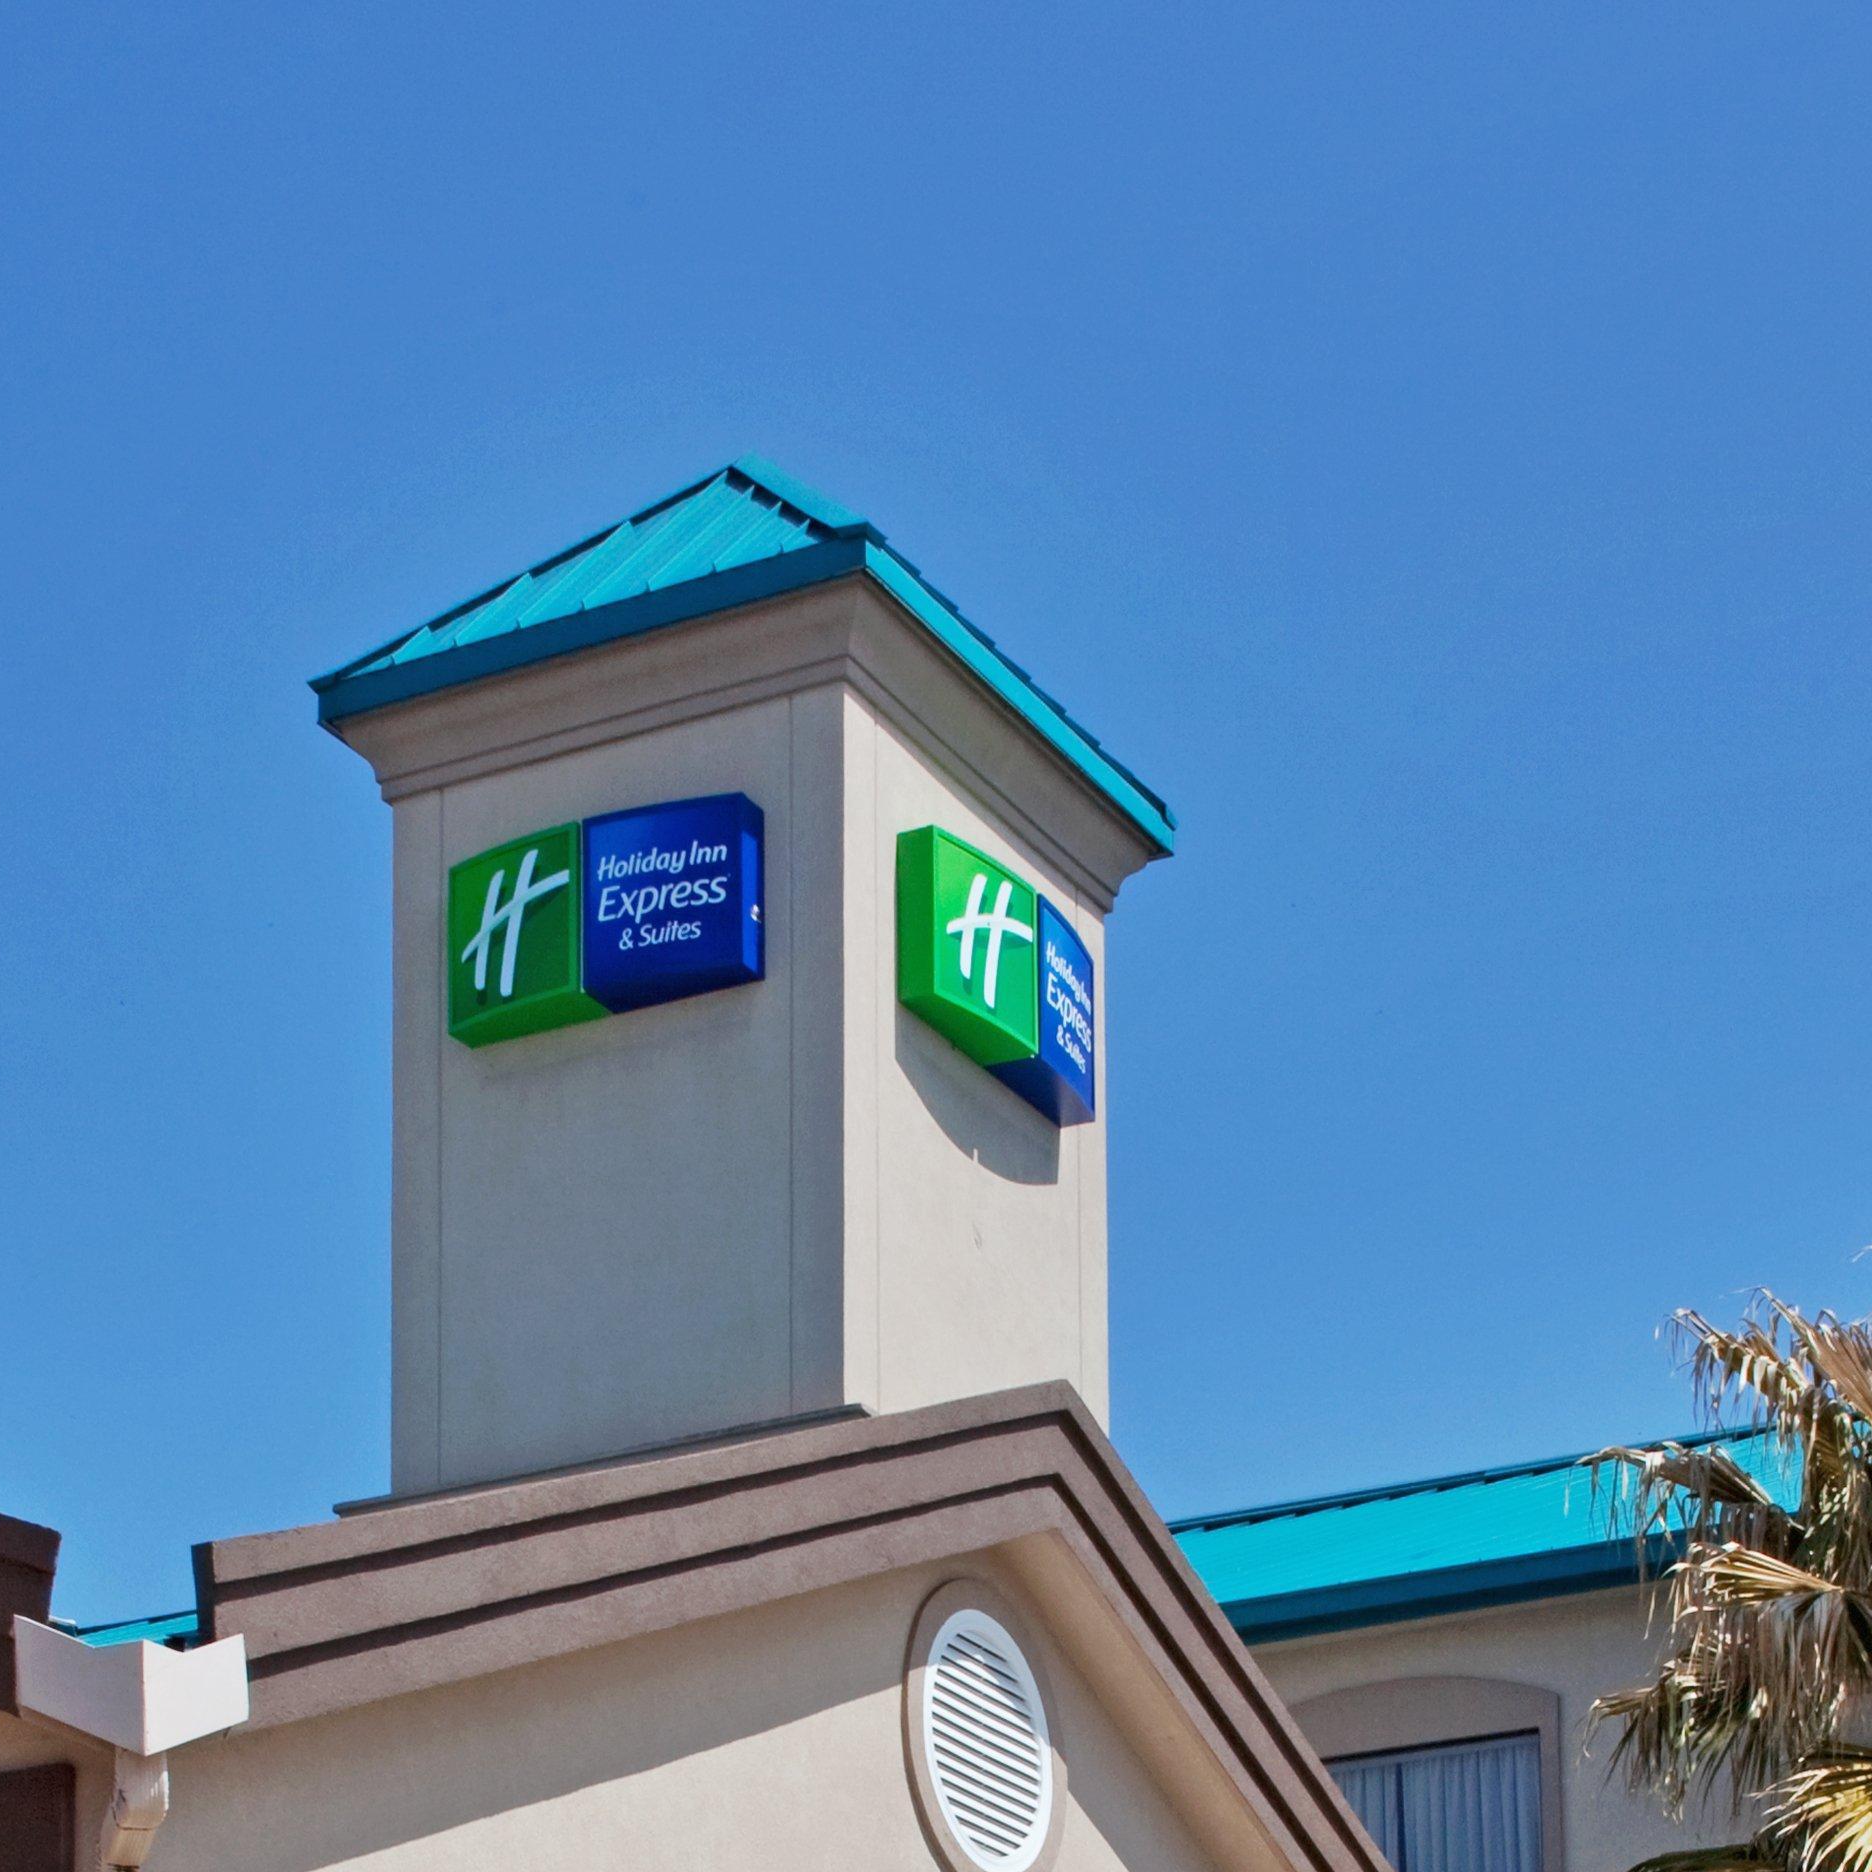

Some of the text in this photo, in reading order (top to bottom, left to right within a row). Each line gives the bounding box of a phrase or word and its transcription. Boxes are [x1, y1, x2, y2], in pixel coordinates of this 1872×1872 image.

[597, 840, 728, 882] Holiday Inn
[597, 876, 728, 924] Express
[618, 920, 702, 950] & Suites
[1046, 941, 1083, 1003] Holiday
[1046, 971, 1092, 1053] Express
[1056, 1024, 1086, 1075] & Suites
